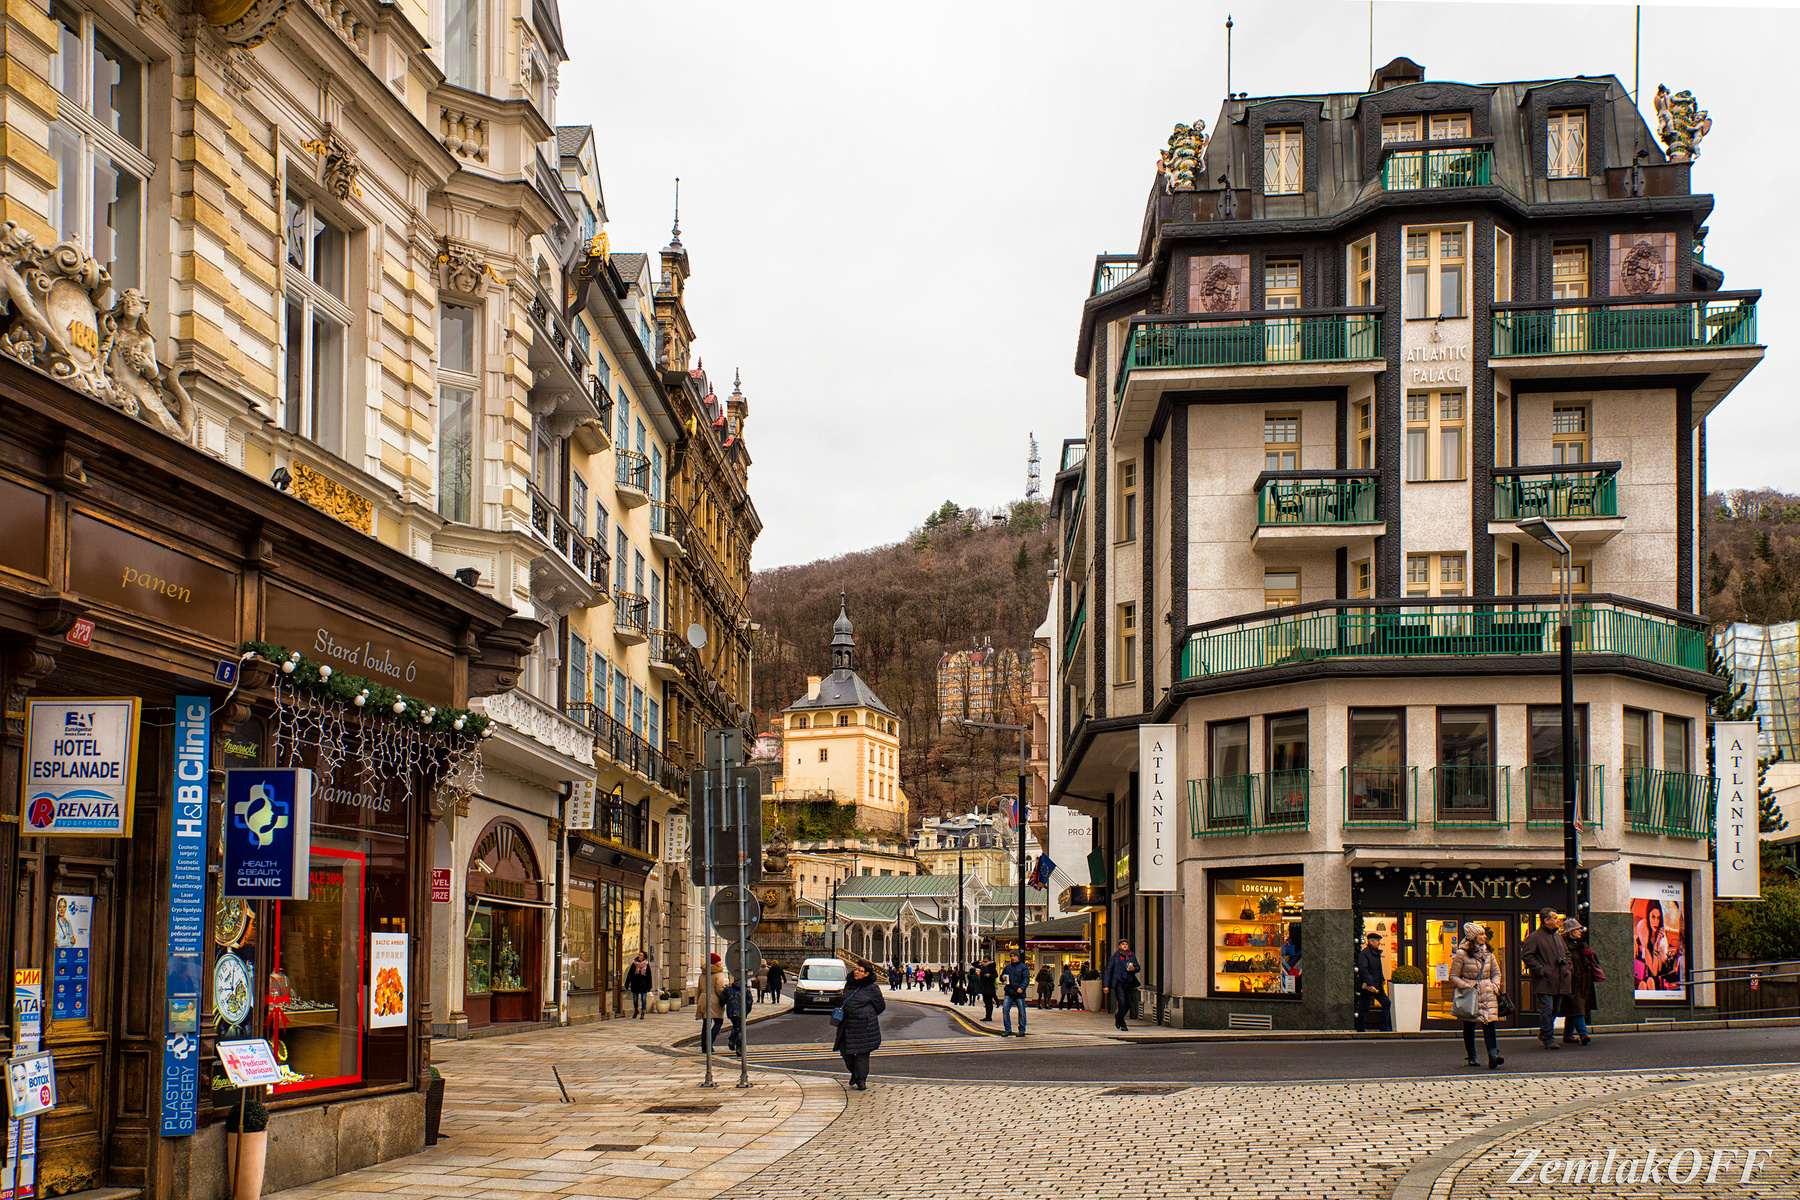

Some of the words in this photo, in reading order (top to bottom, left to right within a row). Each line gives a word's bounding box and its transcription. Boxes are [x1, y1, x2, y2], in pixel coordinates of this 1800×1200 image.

[1406, 345, 1467, 362] ATLANTIC
[1413, 367, 1460, 383] PALACE
[122, 566, 191, 603] panen
[73, 623, 91, 642] 373
[314, 628, 361, 665] Stará
[363, 641, 401, 679] louka
[405, 660, 417, 682] 6
[223, 666, 231, 679] 6
[54, 740, 102, 756] HOTEL
[33, 761, 120, 778] ESPLANADE
[310, 771, 392, 813] Diamonds
[56, 802, 120, 818] RENATA
[572, 783, 580, 828] SIDENCE
[582, 781, 593, 828] OETHE
[1152, 741, 1164, 866] ATLANTIC
[1730, 739, 1745, 871] ATLANTIC
[237, 878, 282, 887] CLINIC
[309, 871, 325, 885] ALE
[326, 873, 345, 885] 30%
[1242, 884, 1283, 894] LONGCHAMP
[1403, 879, 1531, 899] ATLANTIC
[242, 1059, 268, 1068] Pedicure
[245, 1066, 274, 1075] Manicure
[28, 1073, 50, 1089] BOTOX
[165, 1066, 180, 1130] PLASTIC
[180, 1065, 195, 1130] SURGERY
